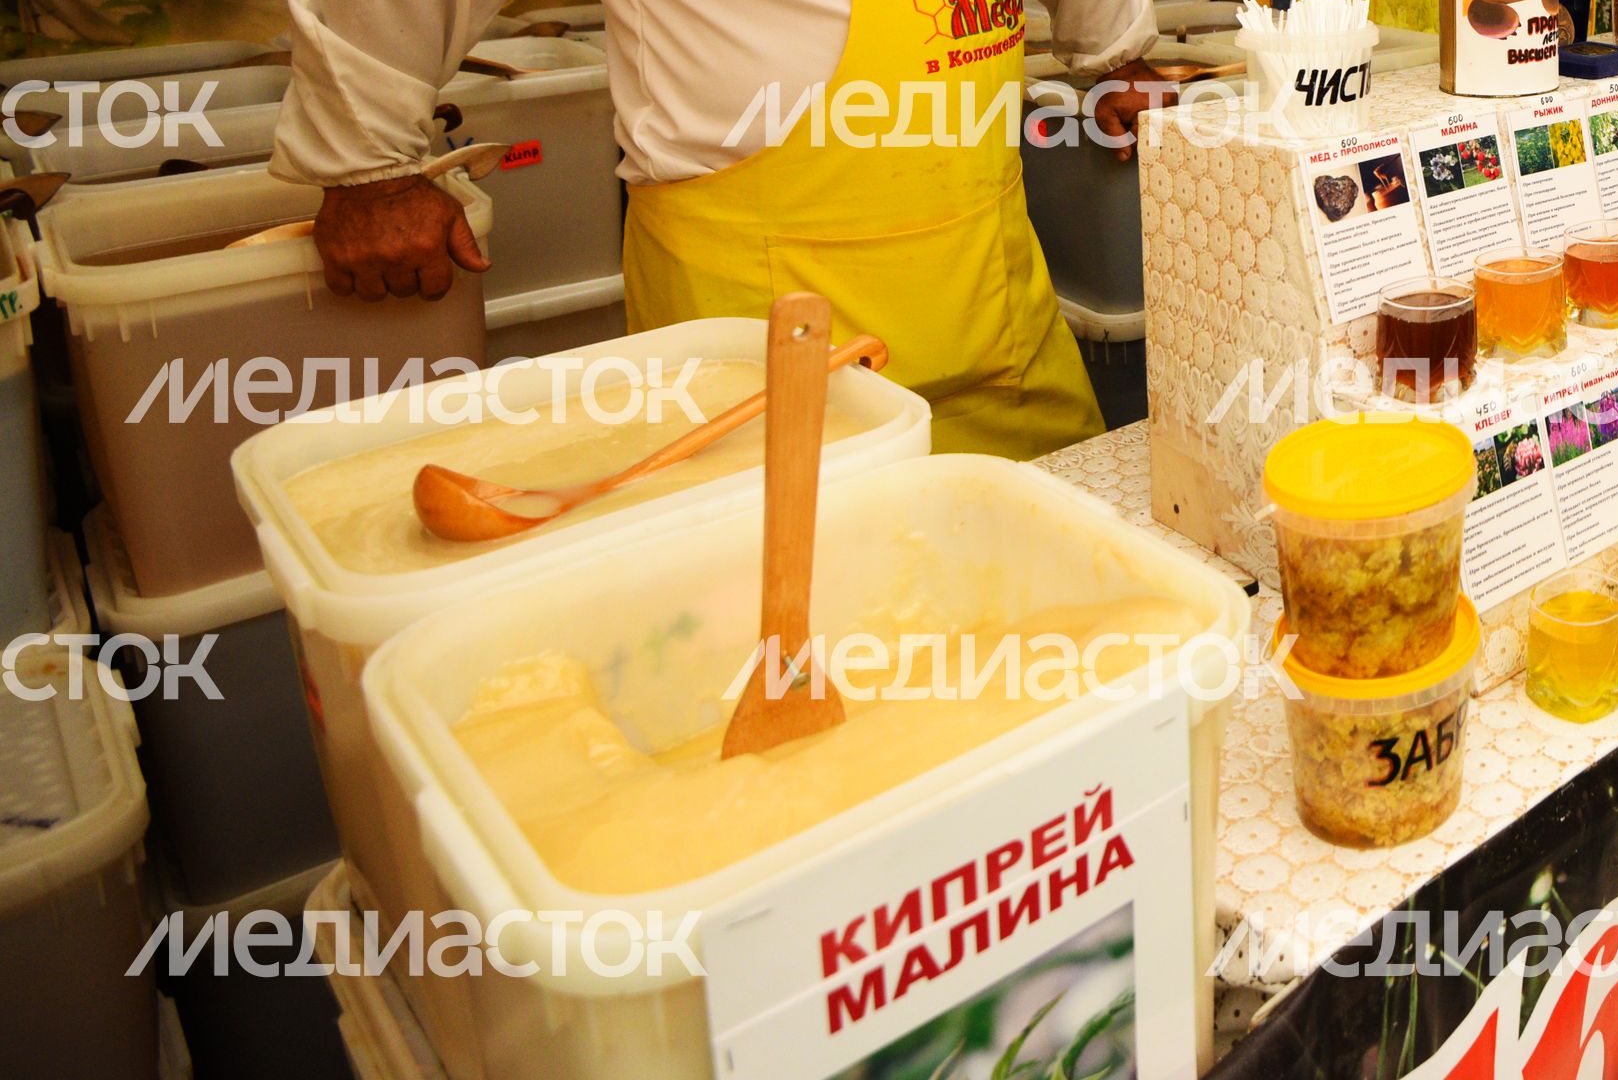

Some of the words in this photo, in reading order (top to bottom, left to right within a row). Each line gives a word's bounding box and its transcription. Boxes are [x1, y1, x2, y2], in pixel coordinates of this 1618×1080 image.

[926, 59, 940, 74] в
[1533, 105, 1564, 119] РЫЖИК
[1441, 121, 1479, 138] МАЛИНА
[1310, 151, 1332, 165] МЁД
[1340, 136, 1399, 157] ПРОПОЛИСОМ
[1543, 383, 1580, 406] КИПРЕЙ
[1474, 409, 1513, 432] КЛЕВЕР
[821, 784, 1117, 979] КИПРЕЙ
[828, 834, 1137, 1036] МАЛИНА
